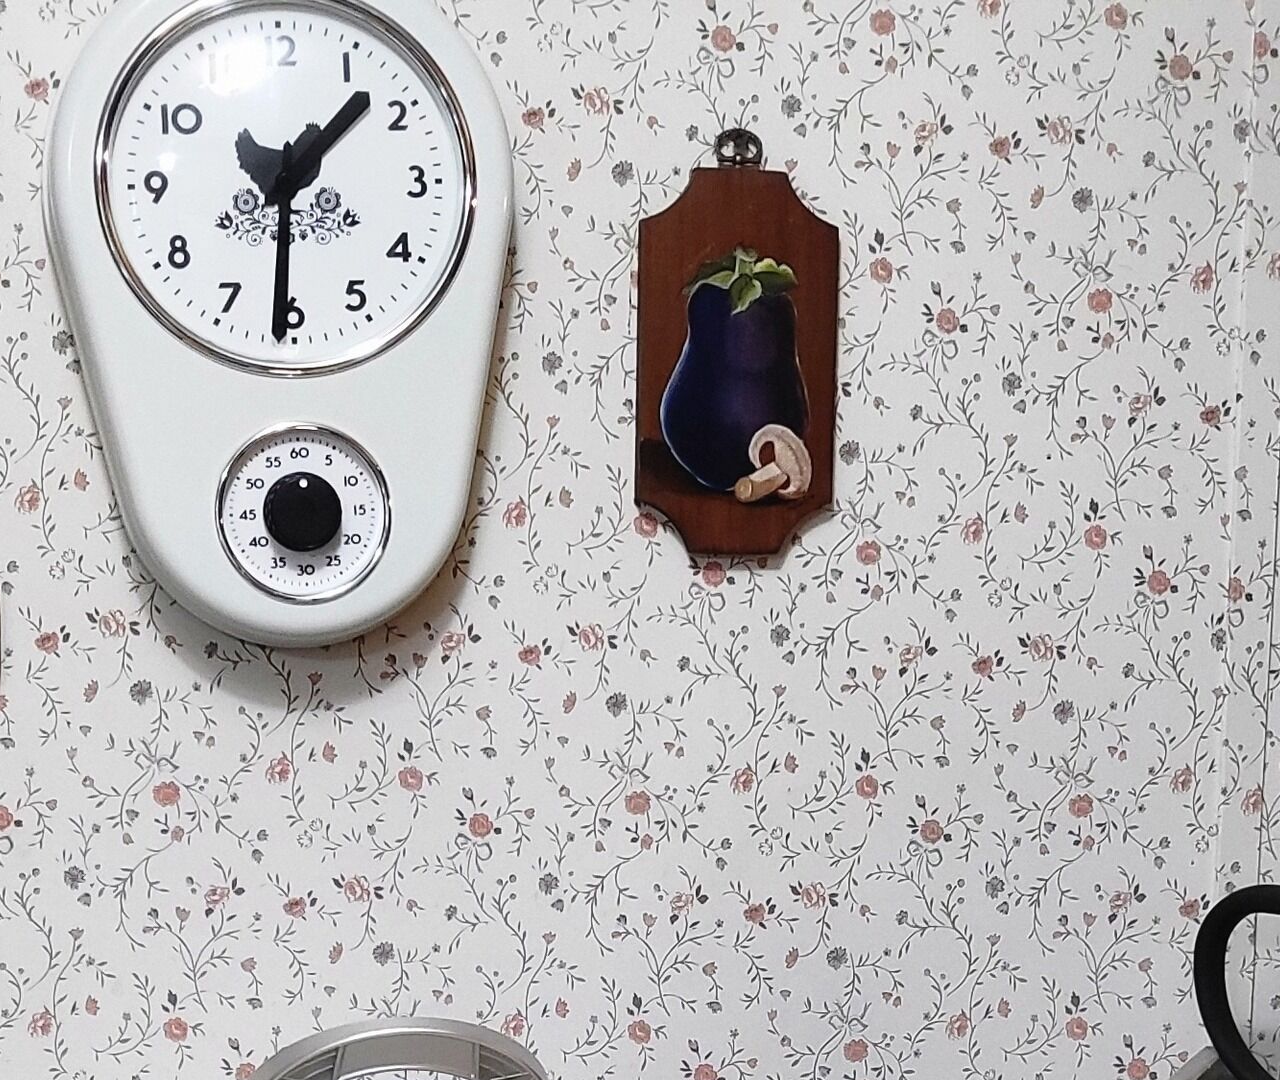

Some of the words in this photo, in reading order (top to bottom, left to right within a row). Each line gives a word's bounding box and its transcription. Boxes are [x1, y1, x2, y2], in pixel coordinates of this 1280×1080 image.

[264, 35, 297, 66] 12
[342, 51, 351, 83] 1
[160, 103, 203, 135] 10
[387, 100, 408, 132] 2
[144, 170, 169, 204] 9
[406, 165, 427, 198] 3
[167, 235, 191, 269] 8
[385, 232, 412, 262] 4
[218, 282, 243, 313] 7
[345, 279, 367, 312] 5
[284, 297, 306, 330] 6
[290, 447, 309, 459] 60
[265, 457, 282, 468] 55
[325, 455, 333, 466] 5
[245, 478, 265, 489] 50
[344, 475, 359, 487] 10
[239, 509, 257, 520] 45
[353, 504, 366, 516] 15
[249, 536, 269, 547] 40
[343, 534, 361, 545] 20
[271, 557, 287, 569] 35
[325, 555, 341, 567] 25
[296, 564, 316, 576] 30
